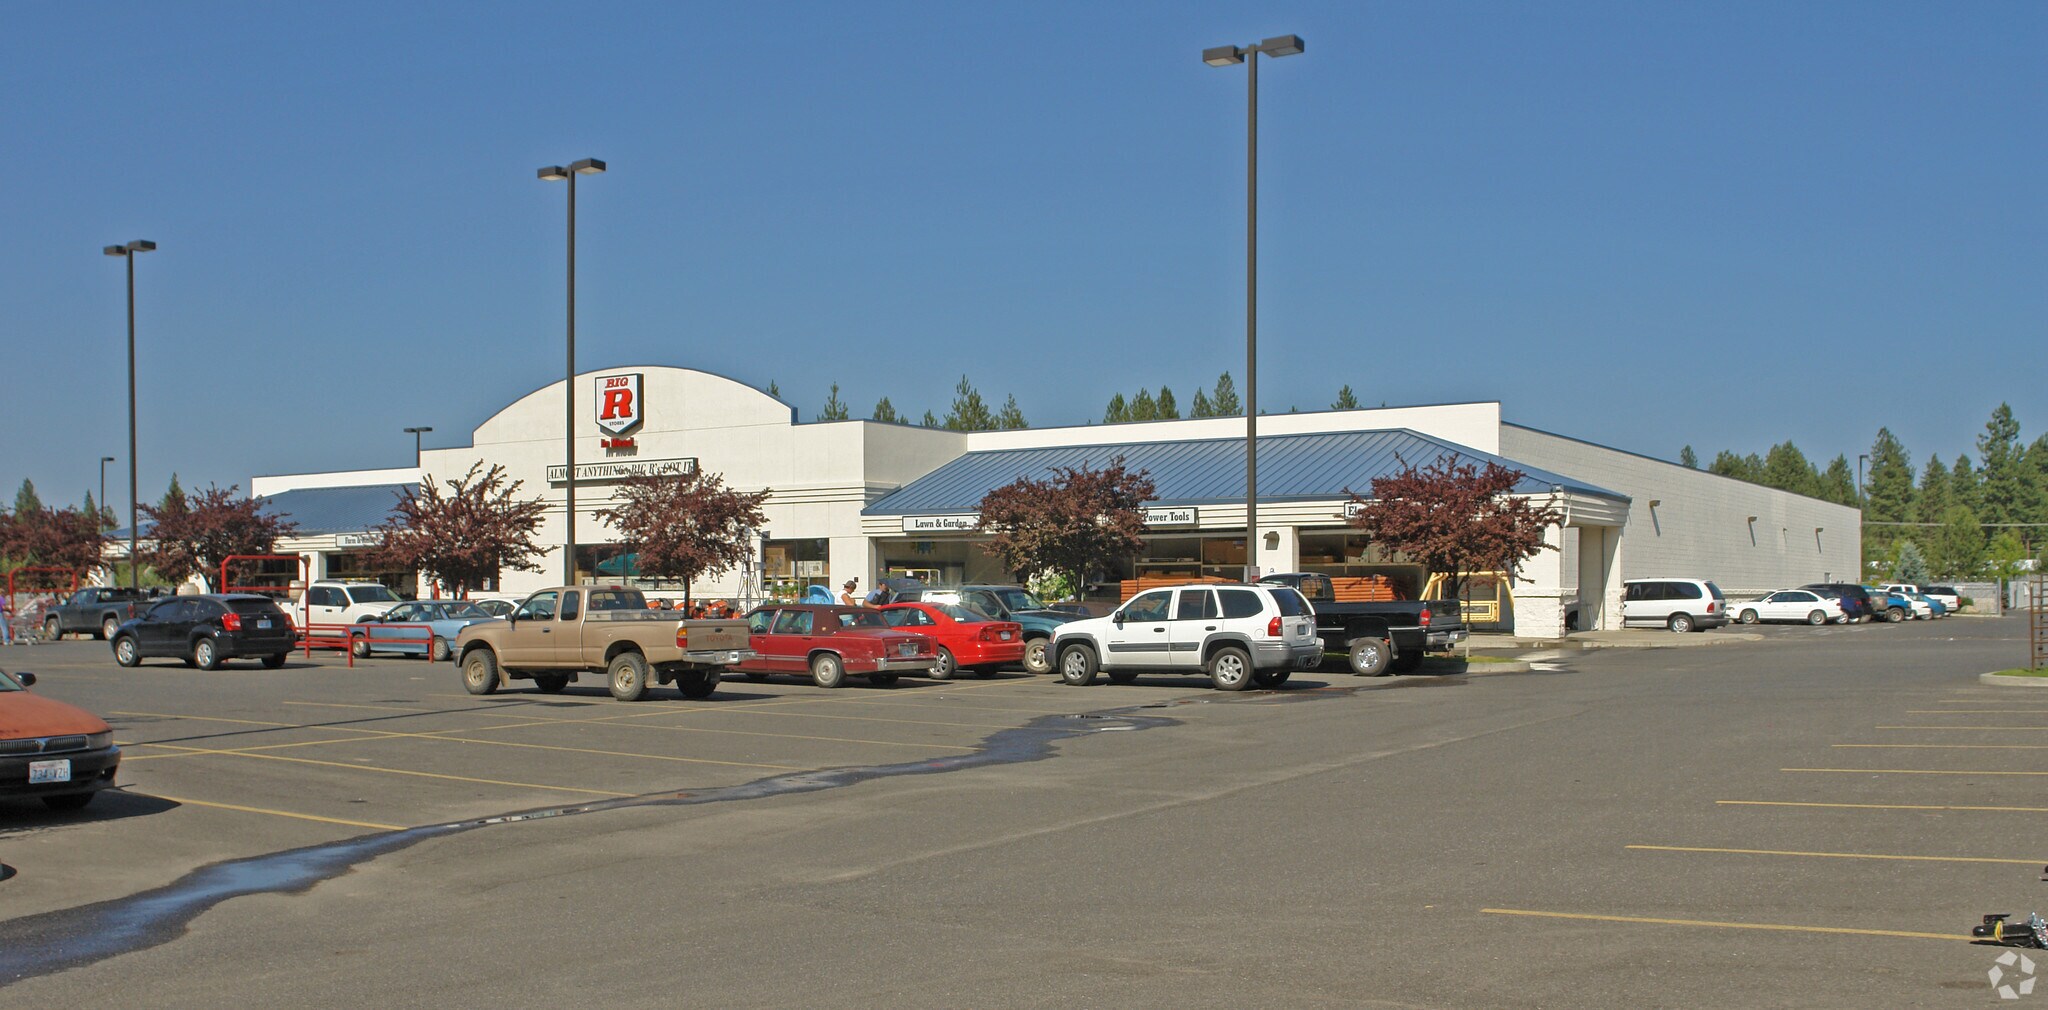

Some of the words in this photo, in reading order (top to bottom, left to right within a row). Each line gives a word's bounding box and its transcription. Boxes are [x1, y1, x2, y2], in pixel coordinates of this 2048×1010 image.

[605, 377, 629, 388] BIG
[600, 388, 633, 420] R
[548, 466, 581, 480] ALMT
[631, 463, 647, 477] BIG
[1143, 511, 1168, 522] Power
[1169, 511, 1190, 521] Tools
[915, 519, 934, 528] Lawn
[935, 518, 942, 528] &
[943, 518, 968, 528] Garden
